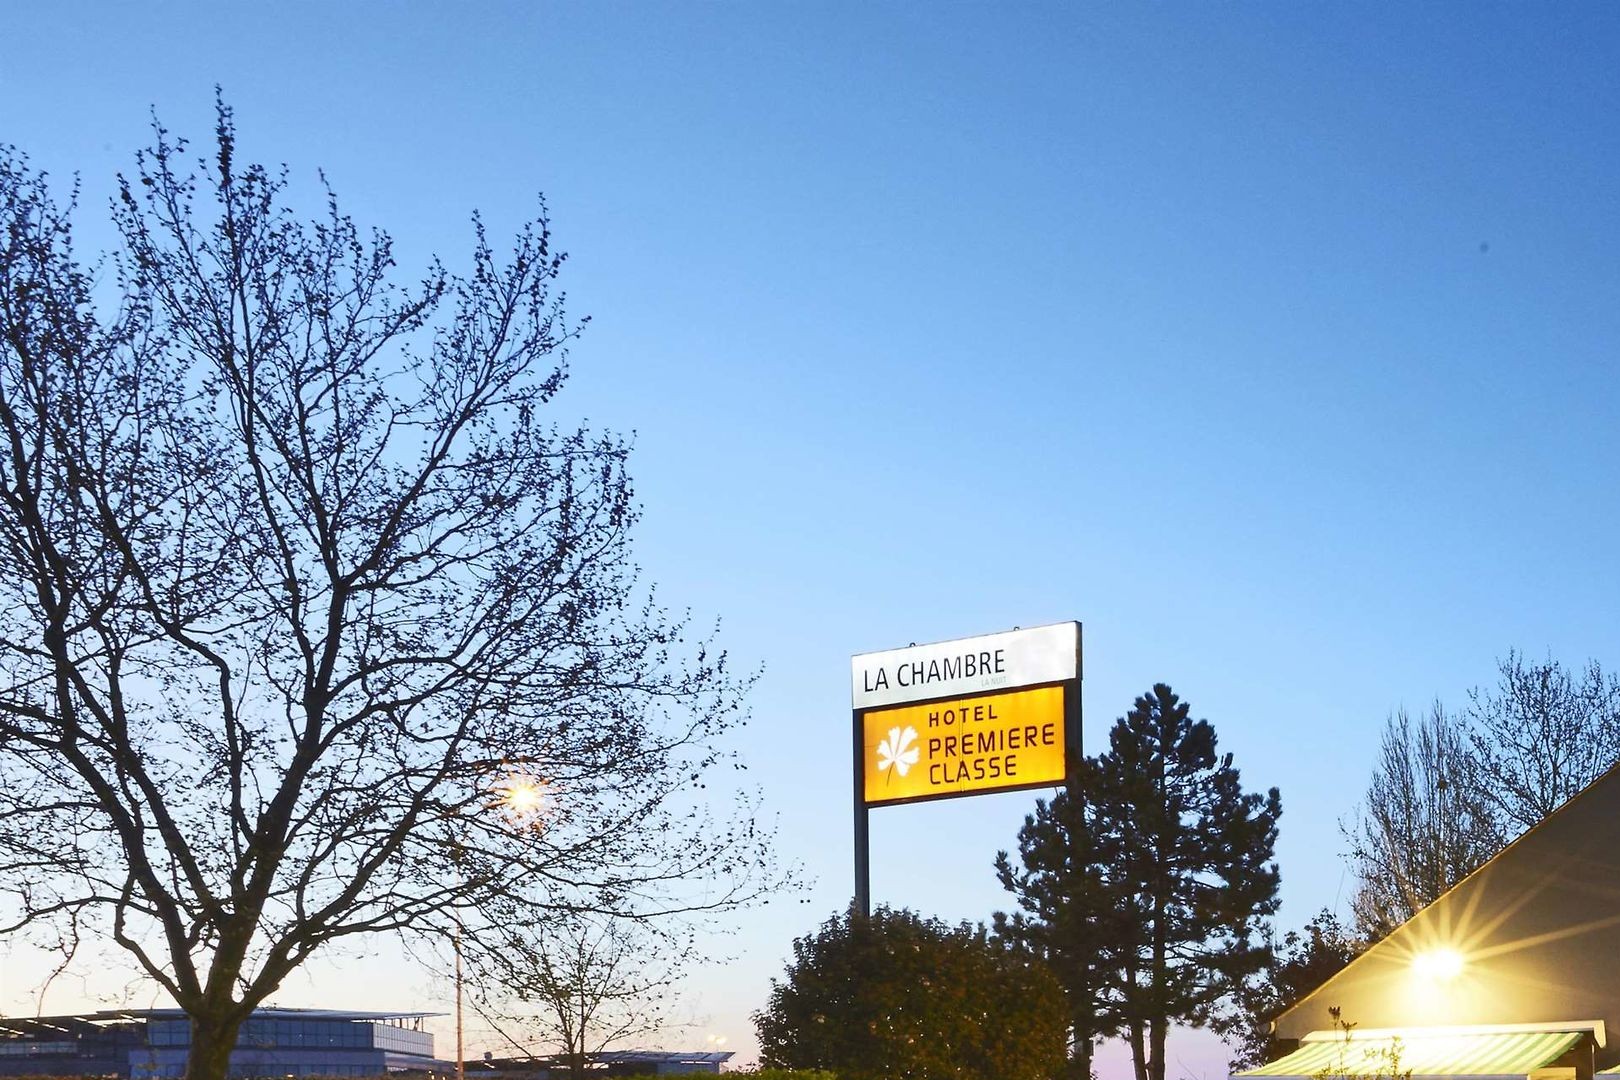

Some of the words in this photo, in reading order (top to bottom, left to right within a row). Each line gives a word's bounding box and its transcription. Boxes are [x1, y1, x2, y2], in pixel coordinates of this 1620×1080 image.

[864, 667, 889, 692] LA
[897, 649, 1005, 687] CHAMBRE
[929, 704, 998, 727] HOTEL
[929, 723, 1055, 759] PREMIERE
[930, 754, 1017, 785] CLASSE
